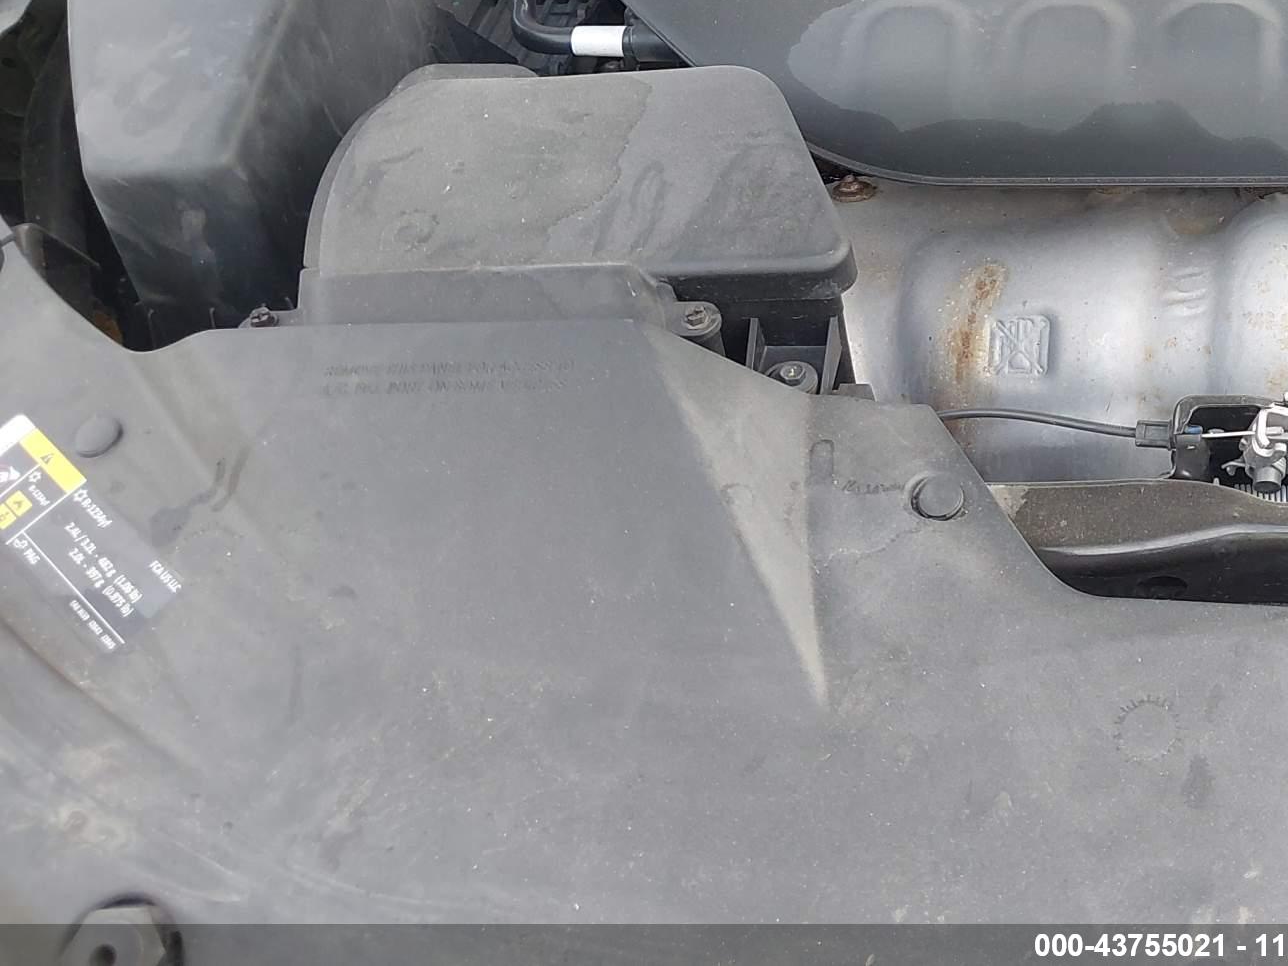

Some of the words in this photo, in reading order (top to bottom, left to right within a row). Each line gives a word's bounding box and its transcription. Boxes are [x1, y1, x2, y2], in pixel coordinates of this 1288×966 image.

[24, 548, 40, 565] PAG
[149, 560, 165, 576] FCA
[160, 571, 172, 583] US
